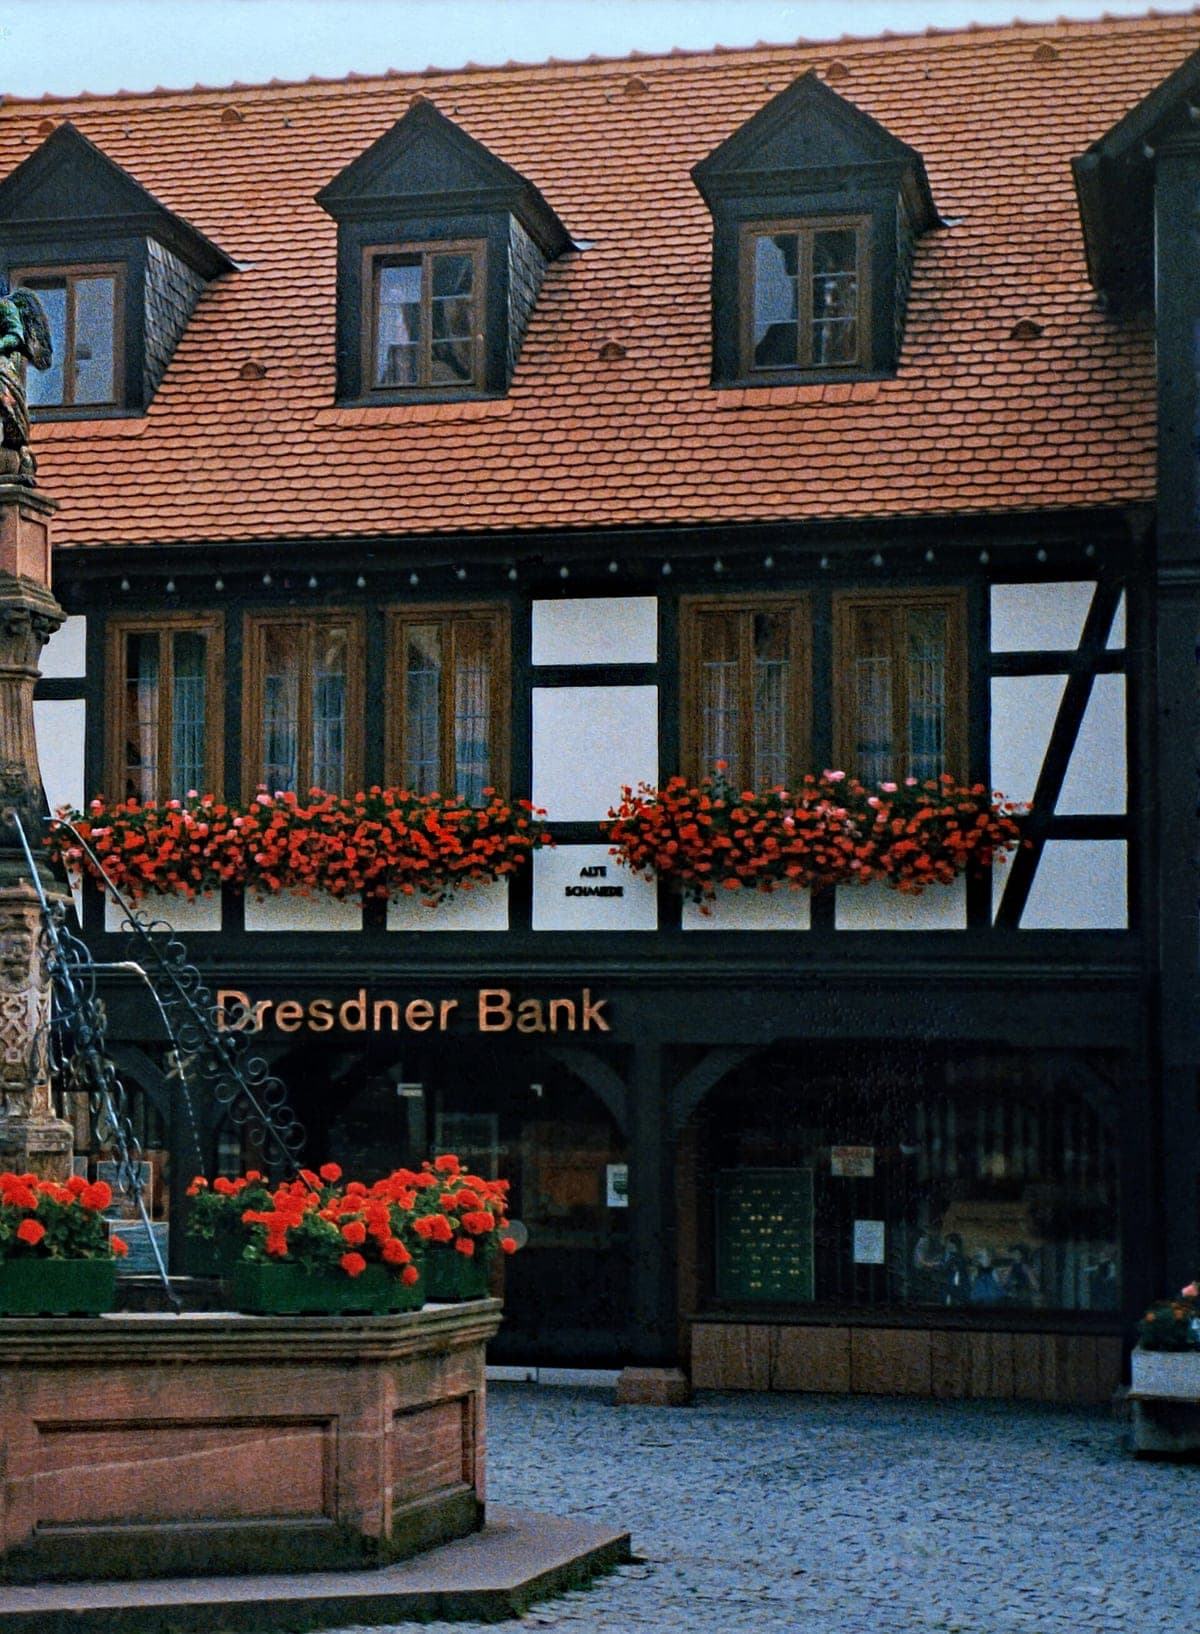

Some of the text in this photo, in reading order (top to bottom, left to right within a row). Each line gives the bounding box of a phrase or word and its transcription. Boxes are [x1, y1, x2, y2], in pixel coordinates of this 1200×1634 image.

[580, 866, 607, 877] ALTE
[565, 886, 624, 897] SCHMIEDE
[216, 988, 611, 1033] Dresdner Bank
